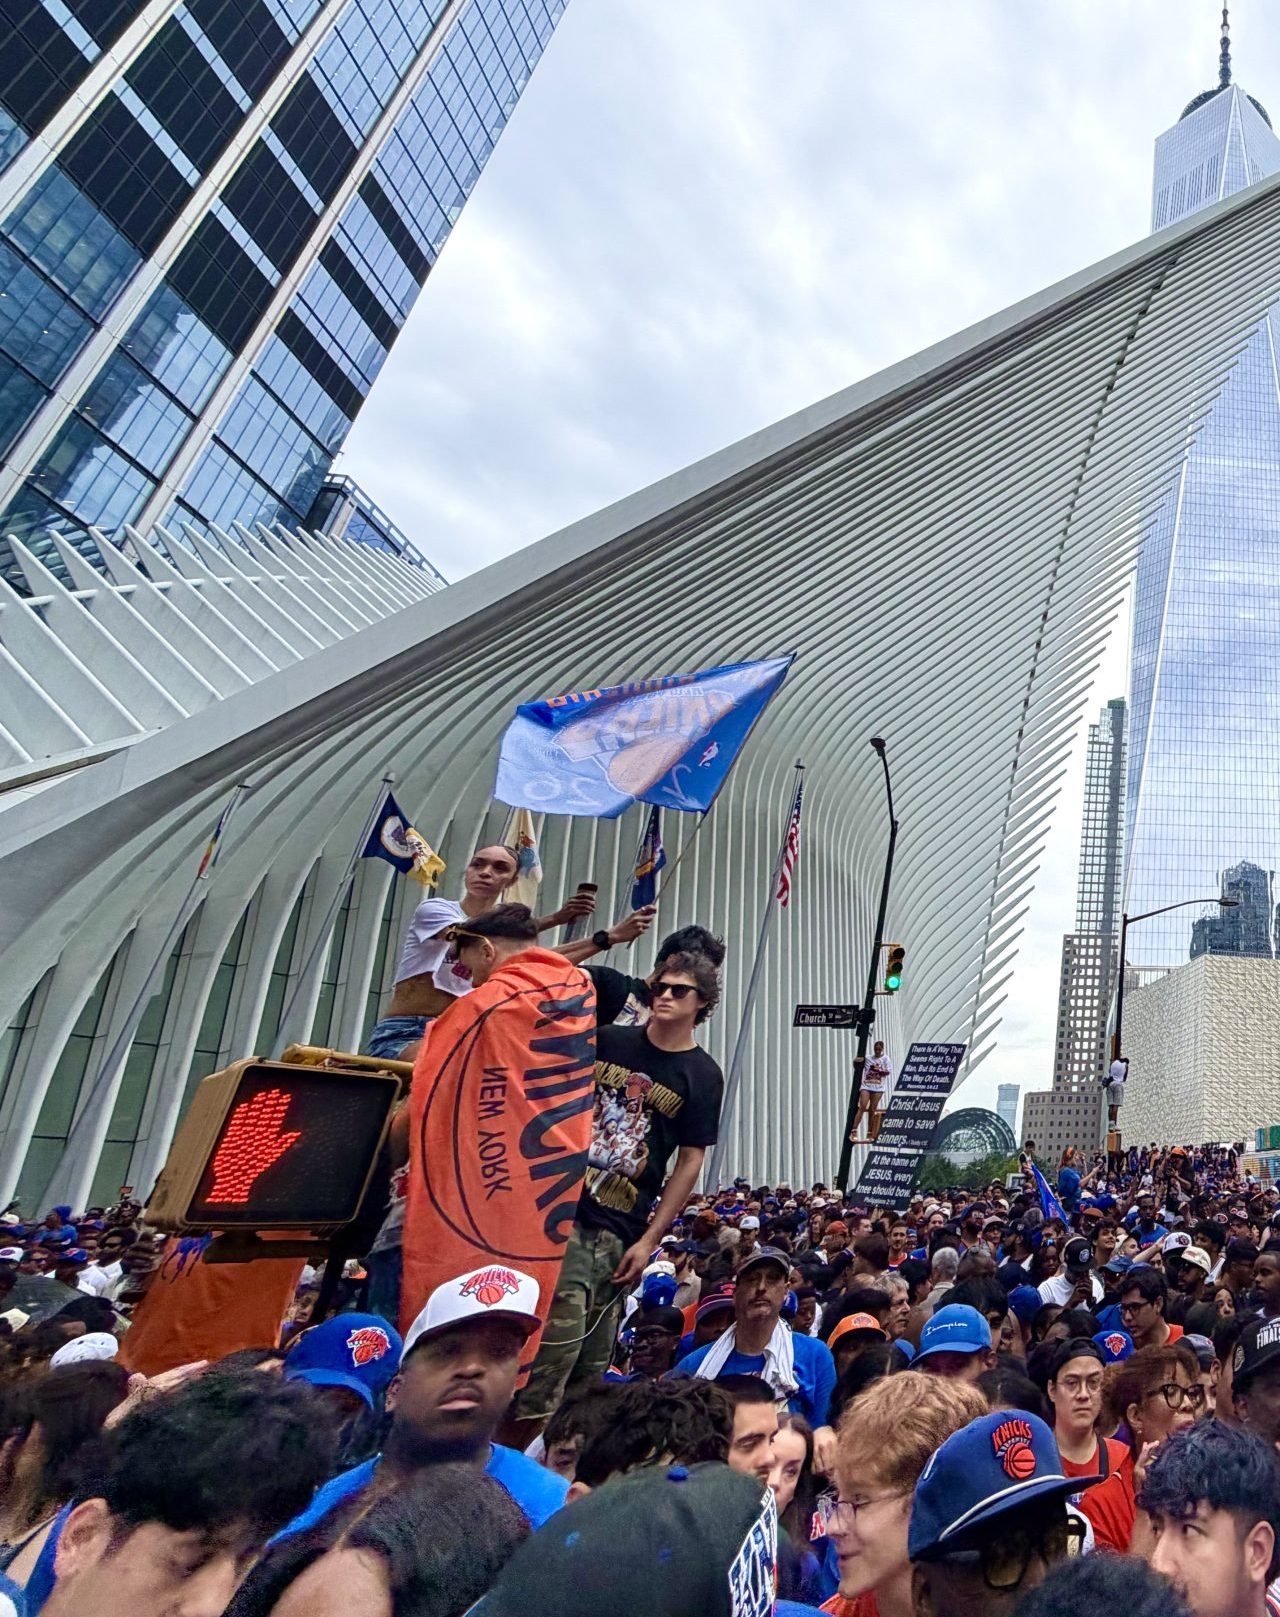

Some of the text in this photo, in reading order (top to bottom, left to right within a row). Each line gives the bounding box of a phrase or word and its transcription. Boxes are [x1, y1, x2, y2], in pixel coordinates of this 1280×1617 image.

[800, 1012, 827, 1024] Church
[912, 1045, 927, 1053] There
[938, 1045, 949, 1055] Way
[951, 1045, 964, 1054] That
[910, 1055, 928, 1063] Seems
[928, 1055, 944, 1064] Right
[945, 1055, 952, 1063] To
[905, 1065, 917, 1073] Man,
[918, 1065, 928, 1073] But
[928, 1065, 936, 1073] Its
[936, 1065, 949, 1073] End
[902, 1074, 912, 1082] The
[912, 1075, 925, 1083] Way
[932, 1075, 950, 1083] Death.
[890, 1098, 941, 1111] Christ Jesus
[882, 1117, 936, 1130] came to save
[876, 1131, 908, 1145] sinners.
[871, 1155, 919, 1168] At the name of
[865, 1169, 914, 1185] JESUS, every
[856, 1183, 911, 1197] knee should bow.
[461, 1270, 519, 1293] KNICKS
[992, 1420, 1033, 1453] KNICKS
